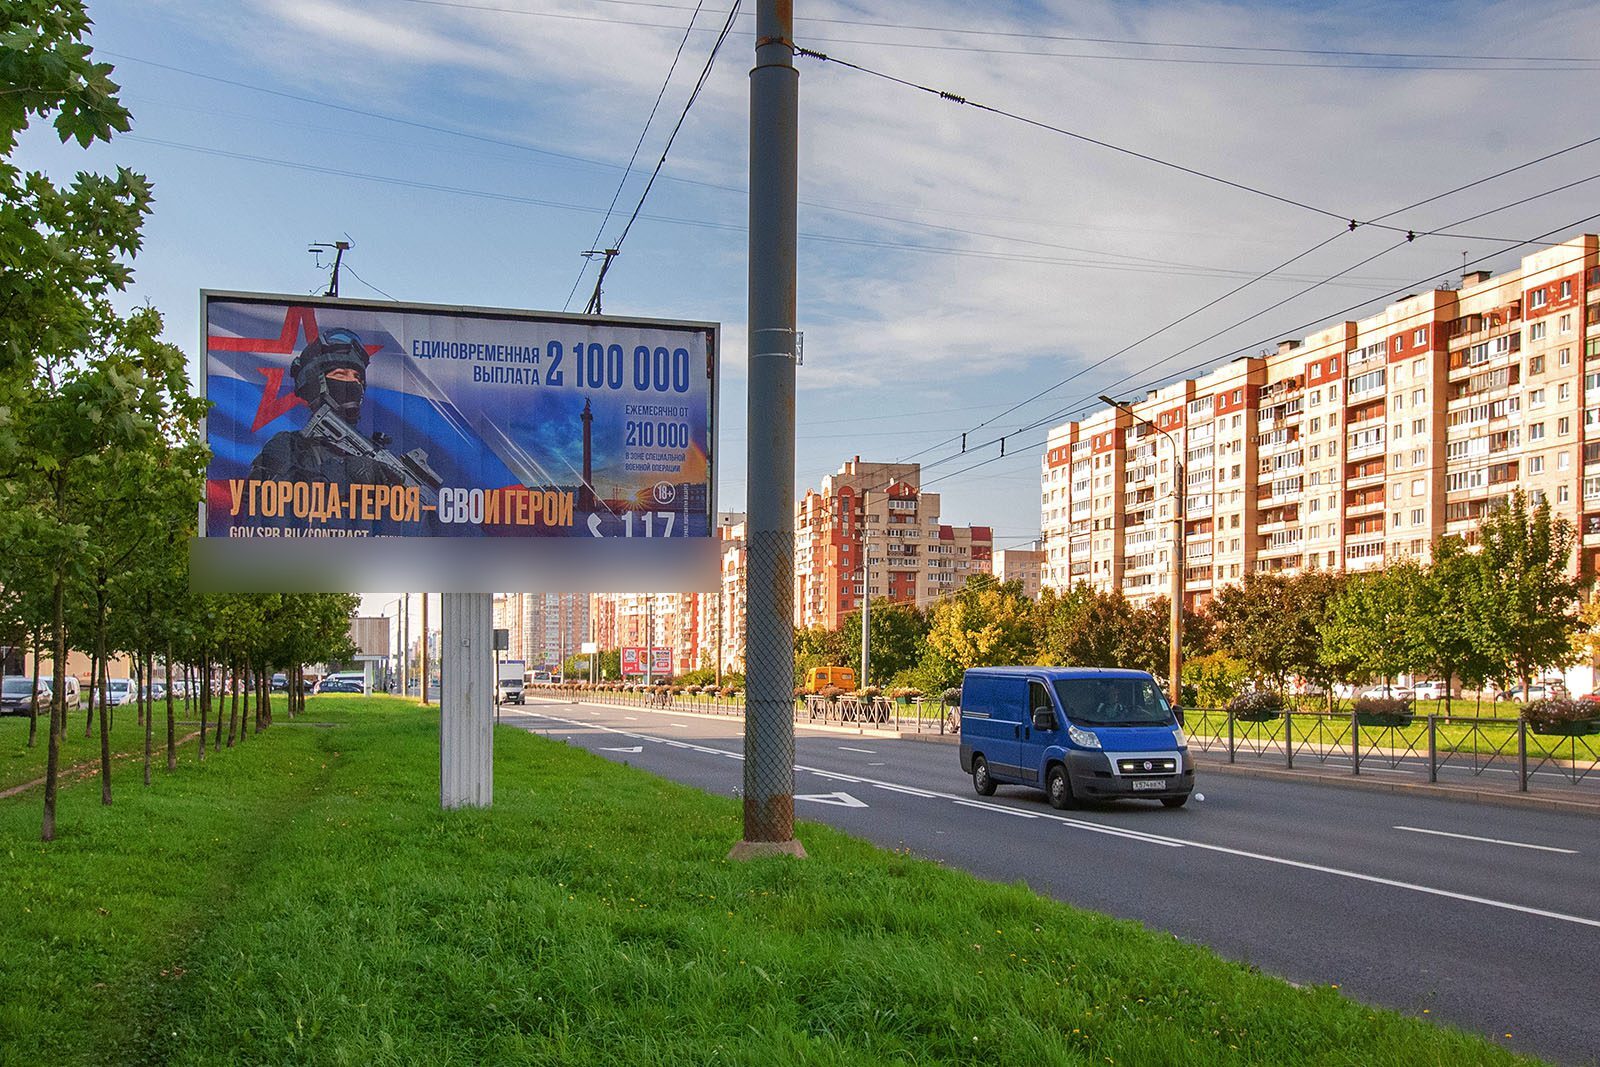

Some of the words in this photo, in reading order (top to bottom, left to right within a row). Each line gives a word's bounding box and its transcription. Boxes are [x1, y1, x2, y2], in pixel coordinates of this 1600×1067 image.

[413, 340, 540, 364] ЕДИНОВРЕМЕННАЯ
[473, 365, 540, 385] ВЫПЛАТА
[546, 340, 563, 387] 2
[573, 342, 623, 390] 100
[633, 345, 690, 393] 000
[626, 404, 678, 417] ЕЖЕМЕСЯЧНО
[680, 407, 689, 417] ОТ
[626, 420, 654, 447] 210
[657, 422, 689, 448] 000
[625, 462, 651, 471] ВОЕННОЙ
[630, 453, 645, 461] ЗОНЕ
[645, 453, 686, 462] СПЕЦИАЛЬНОЙ
[229, 479, 245, 516] У
[249, 480, 420, 523] ГОРОДА-ГЕРОЯ
[438, 487, 499, 525] СВОИ
[504, 491, 574, 527] ГЕРОИ
[657, 484, 673, 500] 18+
[621, 510, 676, 538] 117
